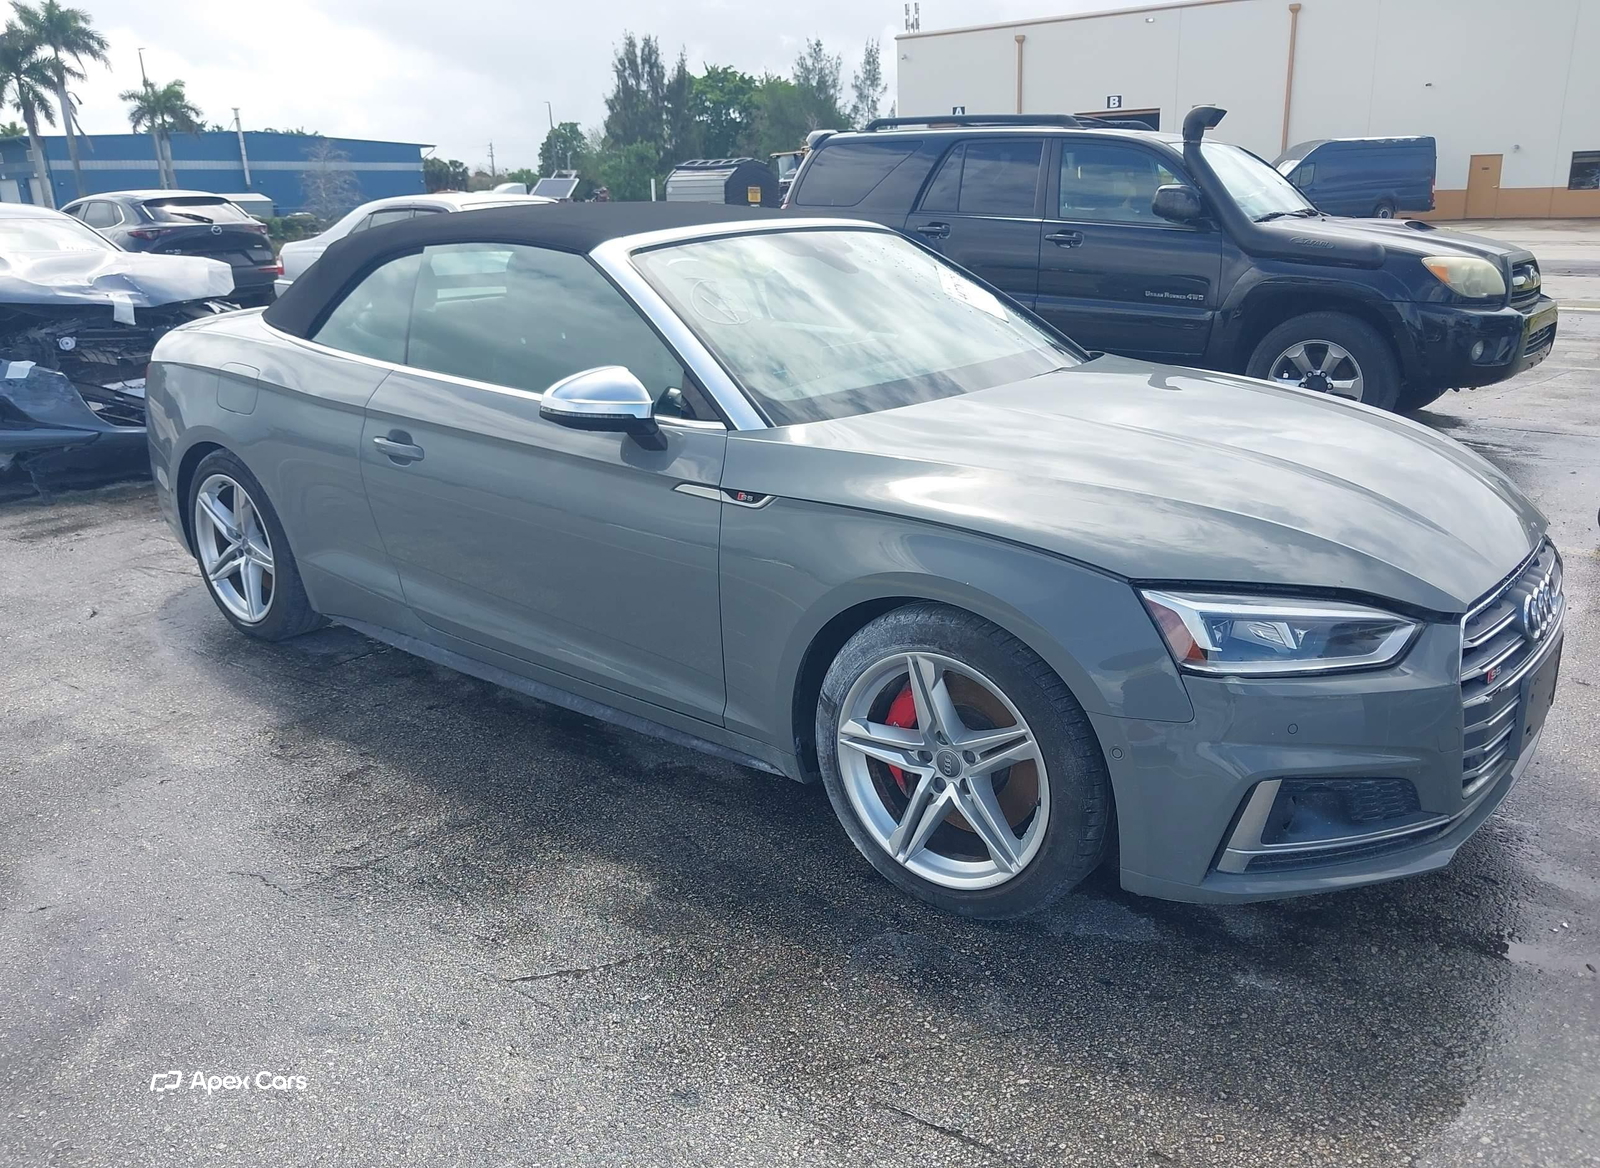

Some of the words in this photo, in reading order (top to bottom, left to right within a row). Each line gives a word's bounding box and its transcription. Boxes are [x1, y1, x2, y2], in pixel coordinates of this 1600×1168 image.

[1110, 96, 1119, 108] B
[955, 107, 963, 116] A
[1186, 293, 1204, 301] 4WD
[1490, 665, 1501, 680] S5
